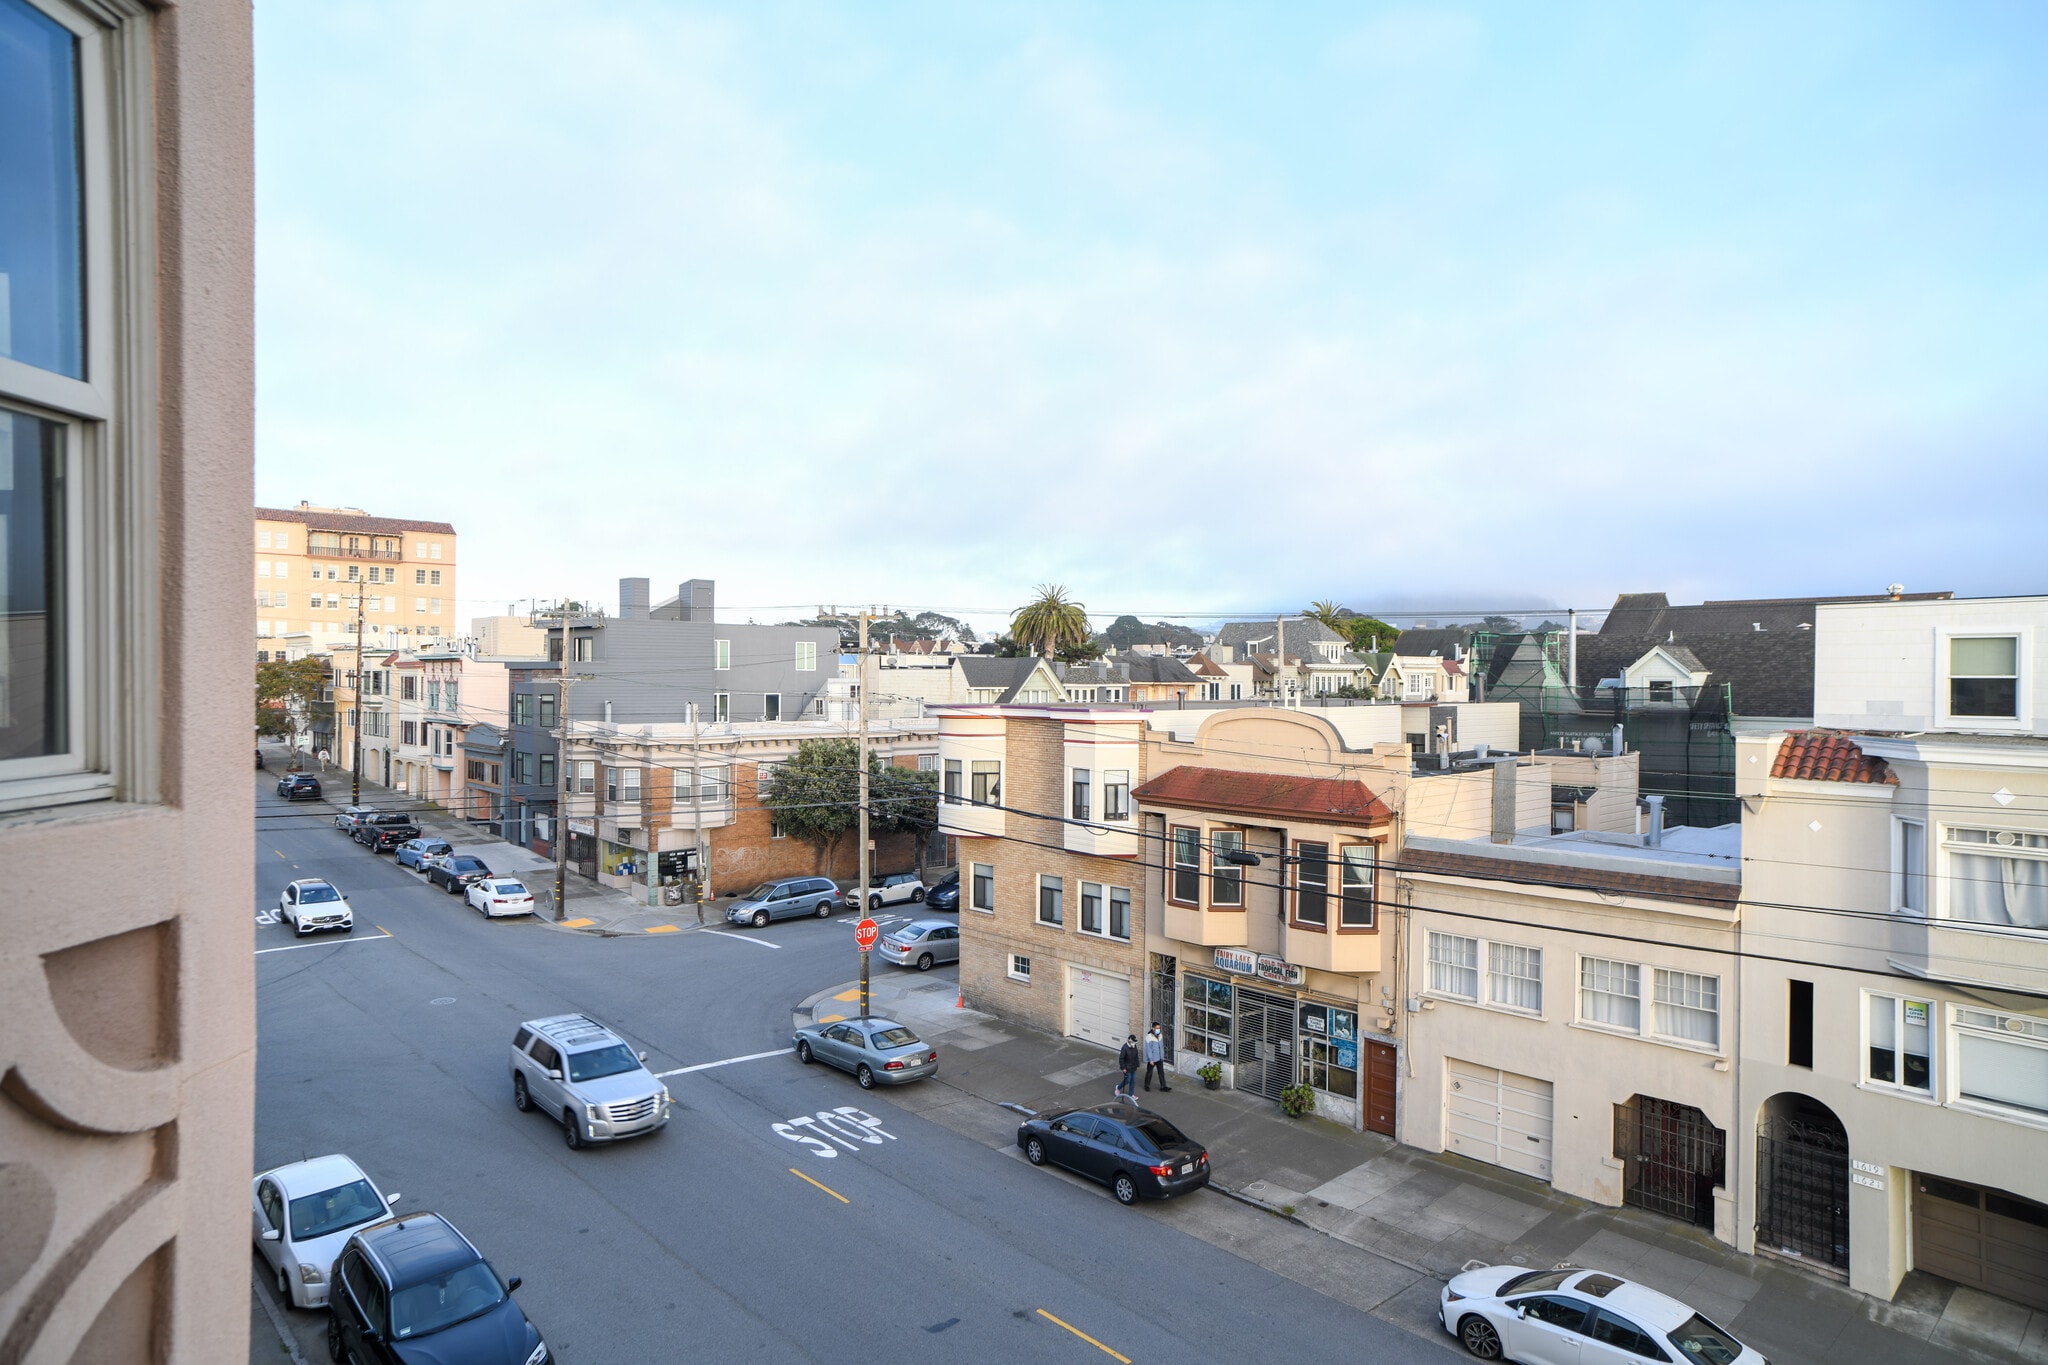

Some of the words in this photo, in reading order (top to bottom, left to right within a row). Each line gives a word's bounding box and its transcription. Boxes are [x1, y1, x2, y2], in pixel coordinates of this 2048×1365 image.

[857, 926, 877, 939] STOP
[1216, 949, 1233, 960] FAIRY
[1235, 953, 1251, 964] LAKE
[1214, 956, 1253, 974] AQUARIUM
[1258, 963, 1283, 976] TROPICAL
[1285, 969, 1298, 979] FISH
[771, 1106, 897, 1158] STOP
[1856, 1160, 1879, 1174] 1619
[1856, 1175, 1880, 1188] 1621
